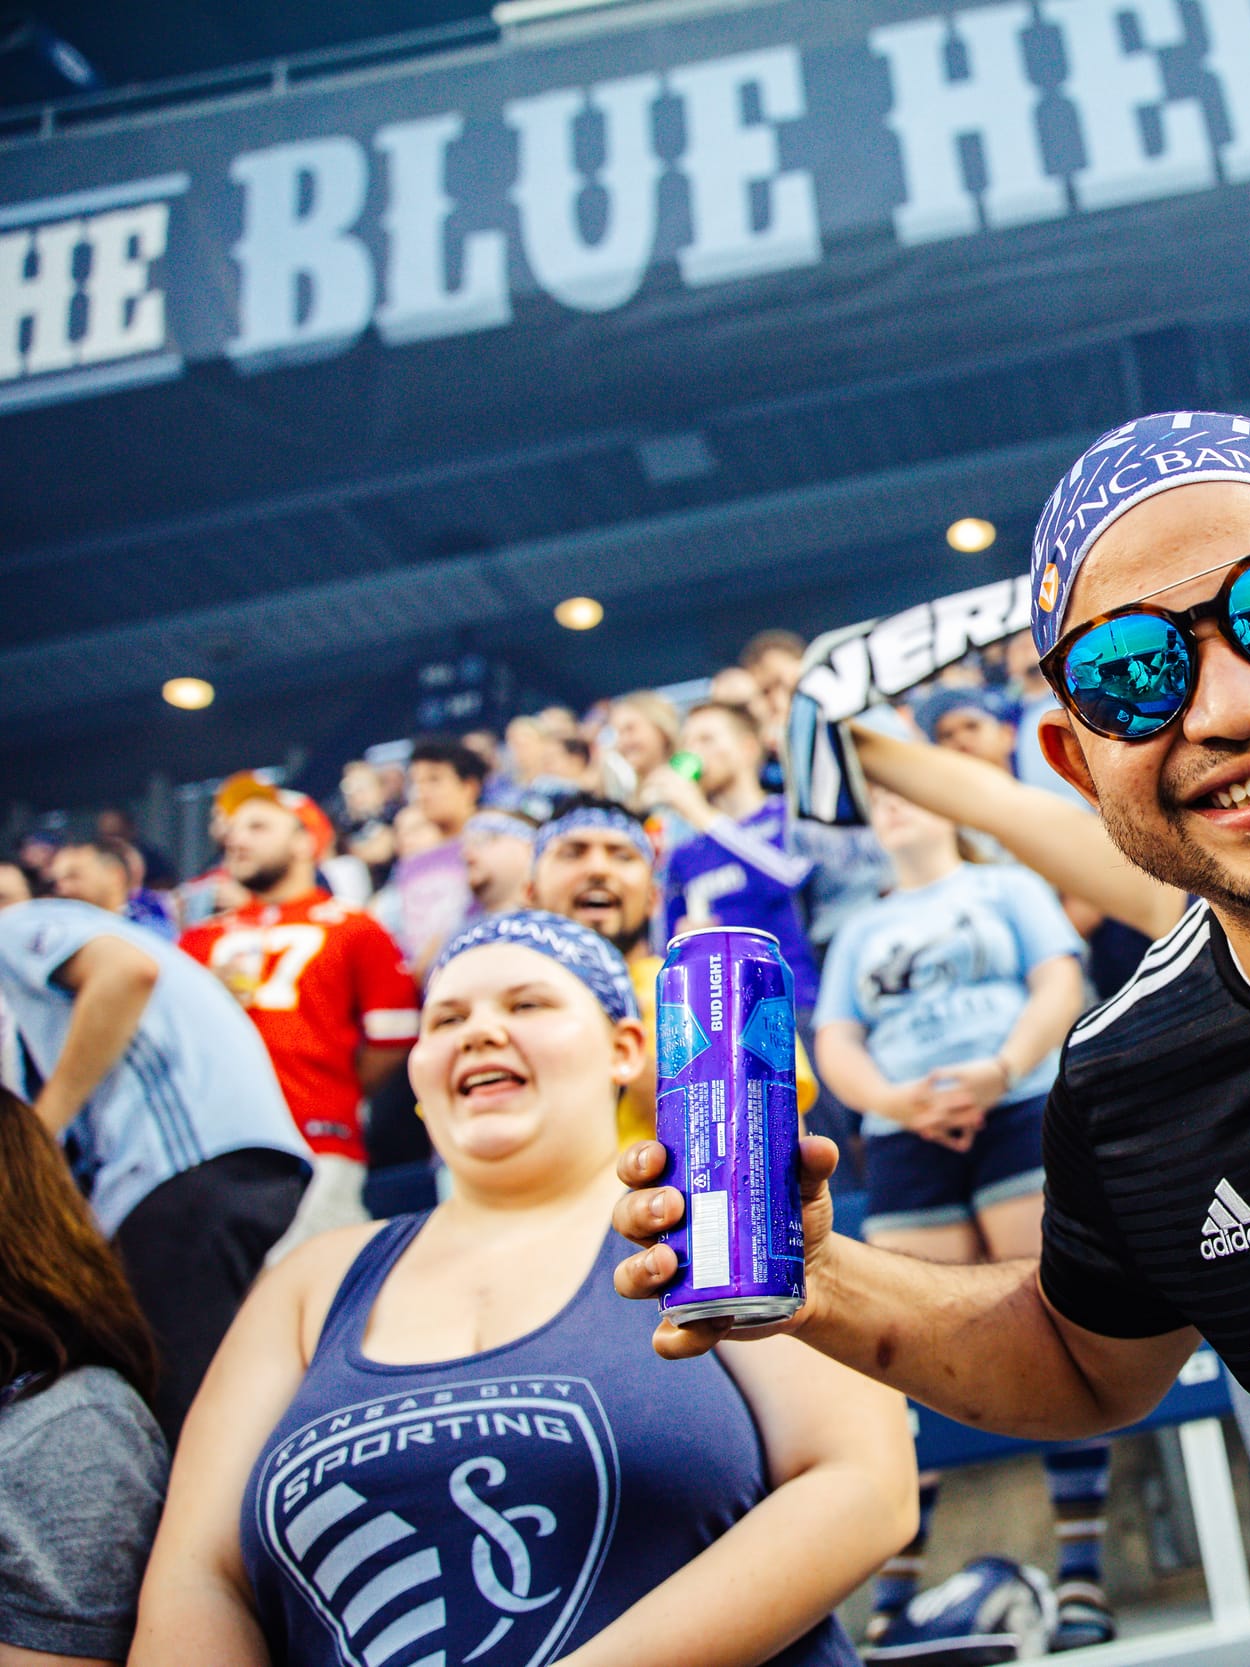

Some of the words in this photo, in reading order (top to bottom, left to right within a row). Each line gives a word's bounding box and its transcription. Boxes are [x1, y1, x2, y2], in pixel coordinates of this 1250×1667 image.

[225, 42, 825, 377] BLUE
[1054, 463, 1147, 560] PNC
[709, 955, 723, 998] LIGHT
[710, 999, 723, 1032] BUD
[275, 1390, 454, 1468] KANSAS
[479, 1382, 572, 1399] CITY
[283, 1412, 574, 1515] SPORTING
